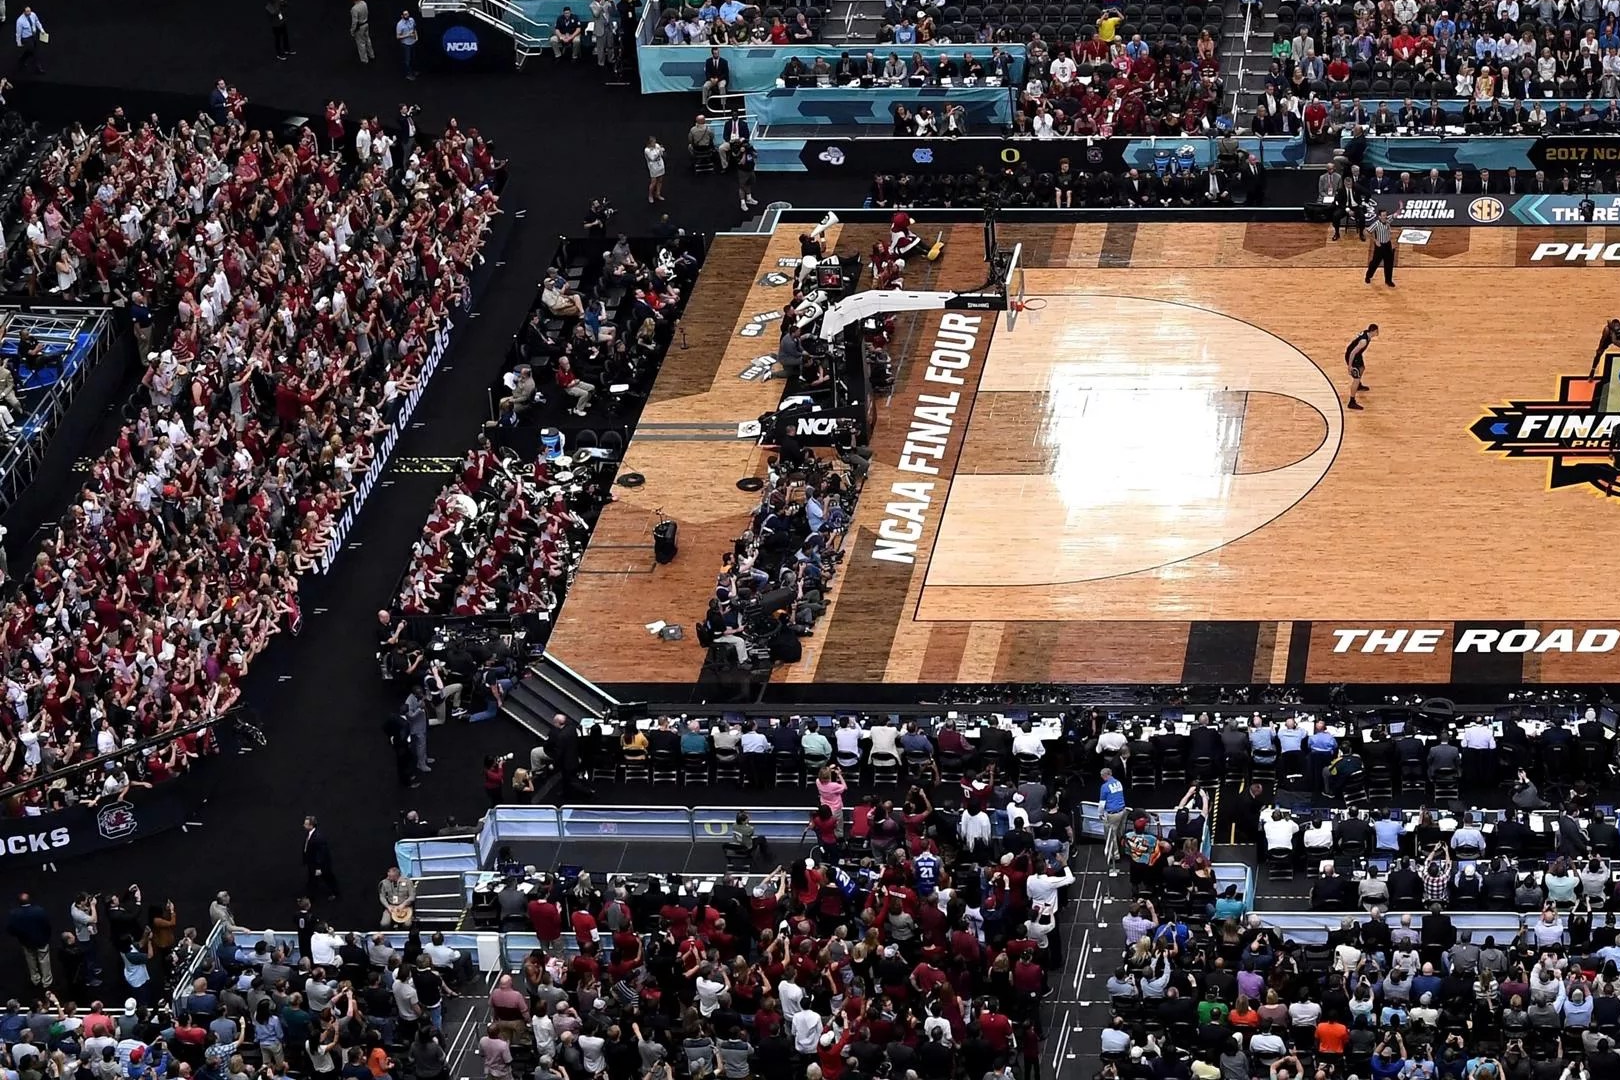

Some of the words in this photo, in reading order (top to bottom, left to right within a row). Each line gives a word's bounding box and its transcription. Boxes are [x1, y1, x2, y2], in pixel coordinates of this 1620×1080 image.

[446, 42, 478, 52] NCAA
[1546, 147, 1589, 161] 2017
[1405, 199, 1447, 209] SOUTH
[1471, 201, 1502, 219] SEC
[1552, 208, 1619, 221] THRE
[925, 313, 982, 386] FOUR
[796, 418, 838, 435] NCA
[898, 391, 961, 475] FINAL
[320, 508, 354, 576] SOUTH
[353, 425, 400, 516] CAROLINA
[871, 482, 935, 564] NCAA
[1331, 629, 1445, 654] THE
[919, 867, 935, 879] 21
